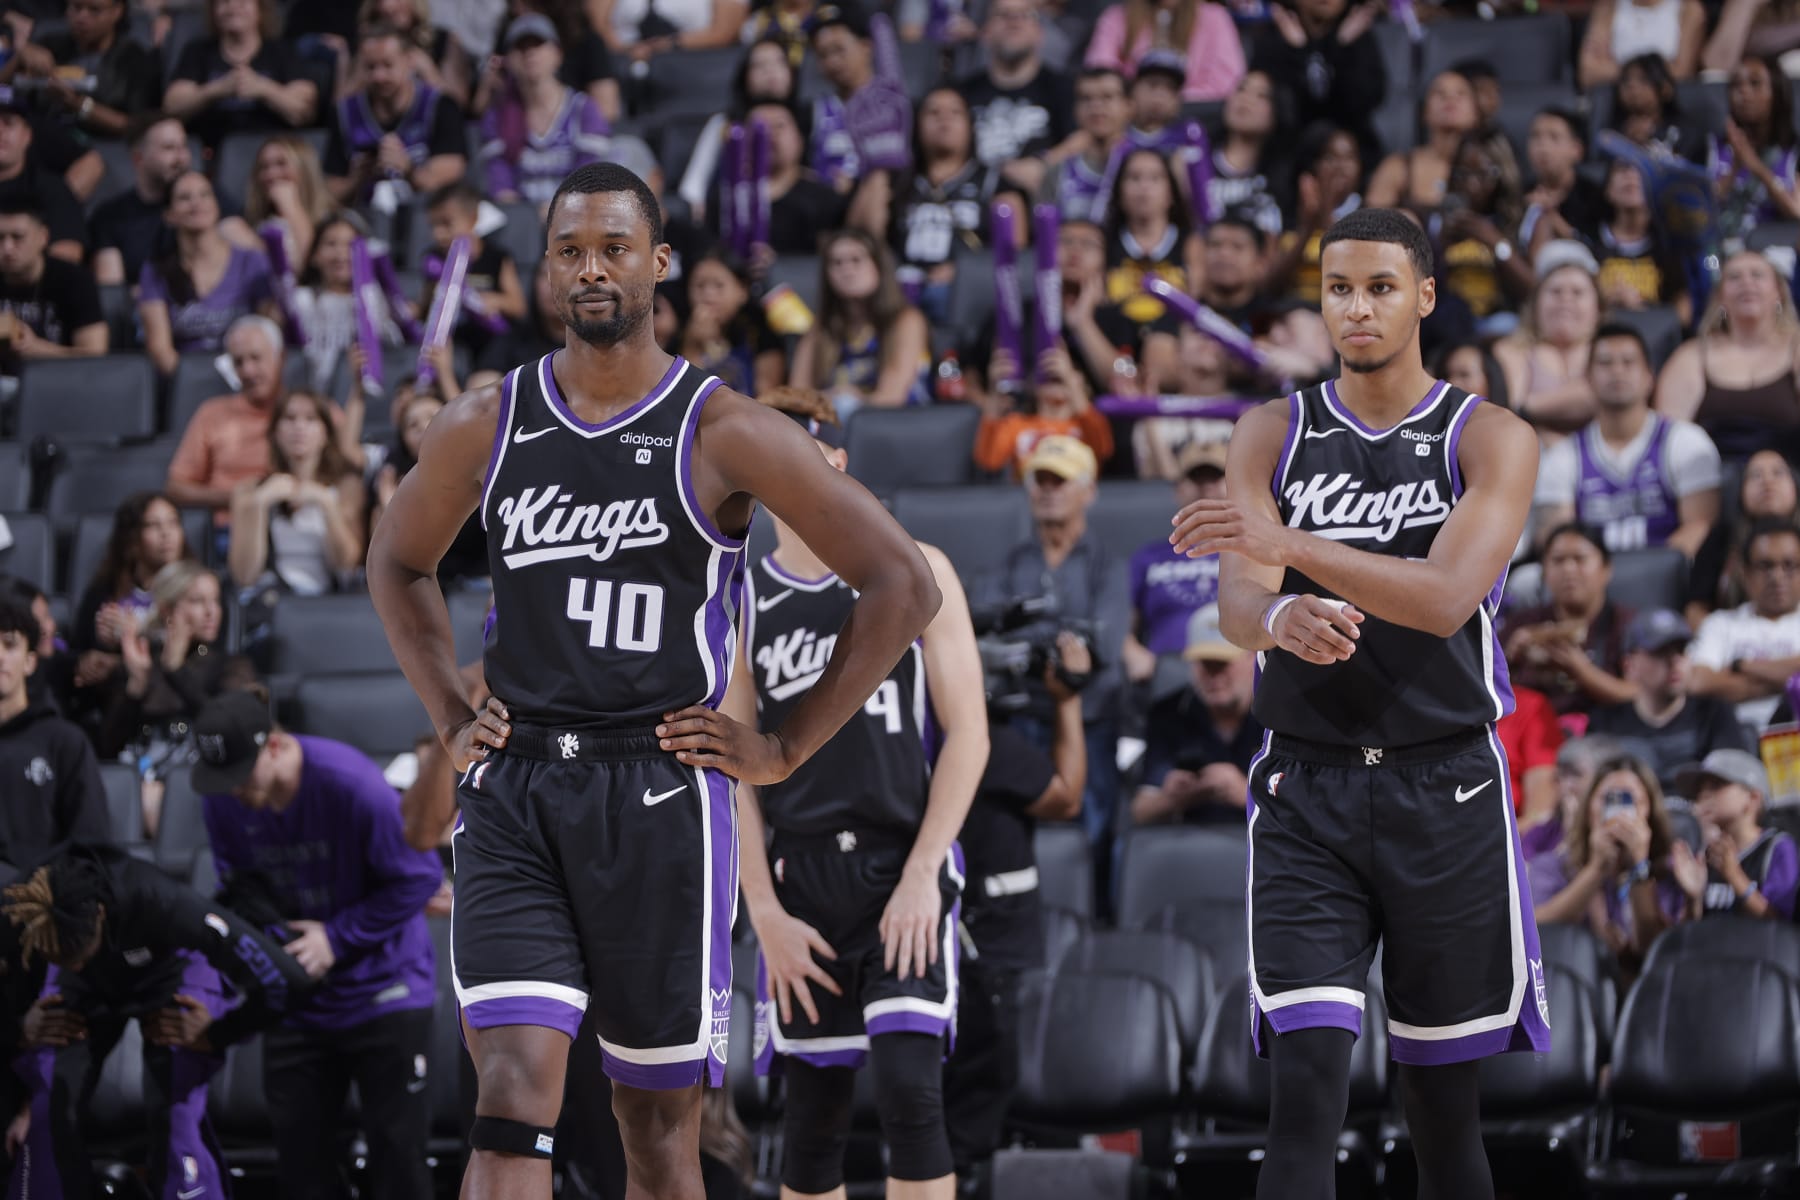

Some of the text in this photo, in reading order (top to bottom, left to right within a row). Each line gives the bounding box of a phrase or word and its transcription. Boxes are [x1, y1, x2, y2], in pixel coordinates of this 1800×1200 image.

[619, 431, 673, 448] dialpad
[497, 484, 670, 567] Kings
[1284, 473, 1451, 543] Kings
[566, 576, 665, 653] 40
[755, 627, 839, 698] Kin
[863, 678, 903, 735] 9
